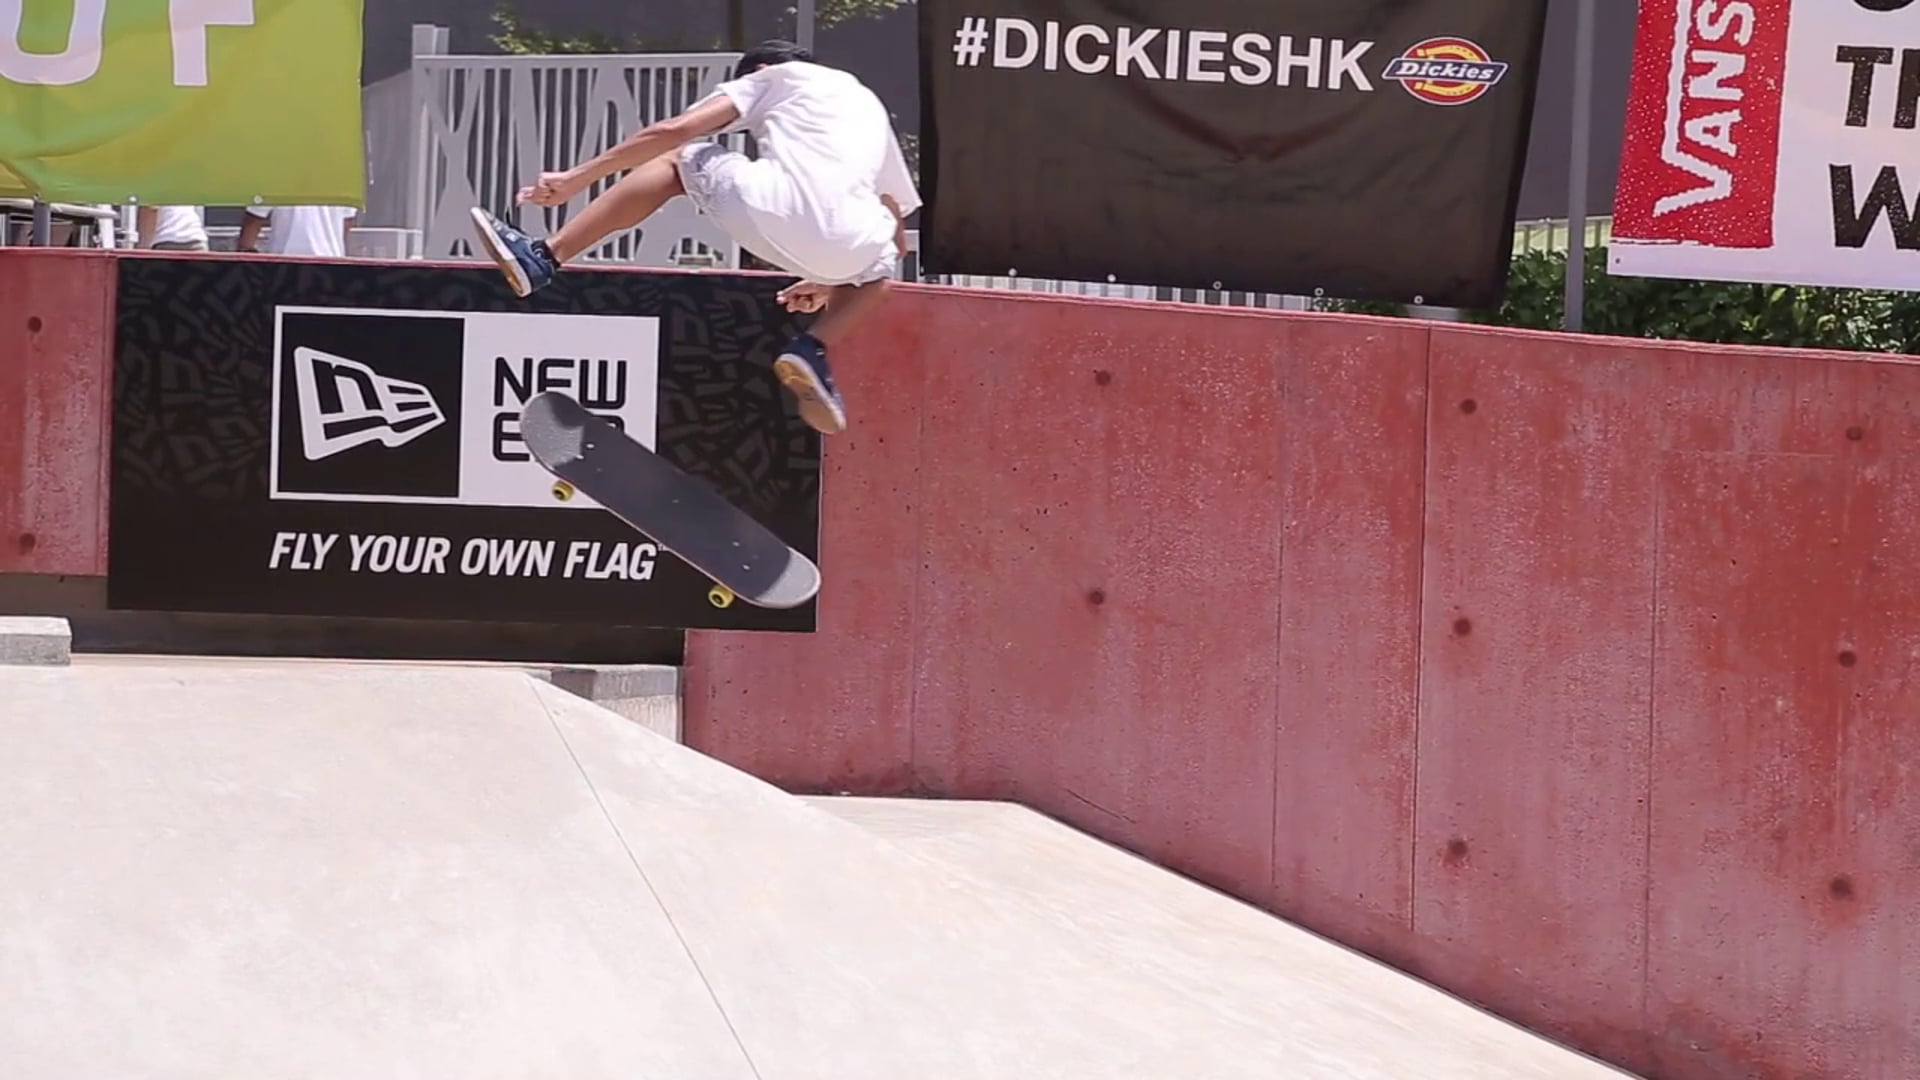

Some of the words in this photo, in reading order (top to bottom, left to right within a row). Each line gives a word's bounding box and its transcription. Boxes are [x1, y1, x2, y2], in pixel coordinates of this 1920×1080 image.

[953, 17, 1375, 91] #DICKIESHK
[1395, 61, 1495, 79] Dickies
[1653, 0, 1756, 218] VANS
[494, 356, 628, 411] NEW
[269, 532, 340, 570] FLY
[349, 534, 451, 574] YOUR
[459, 538, 556, 577] OWN
